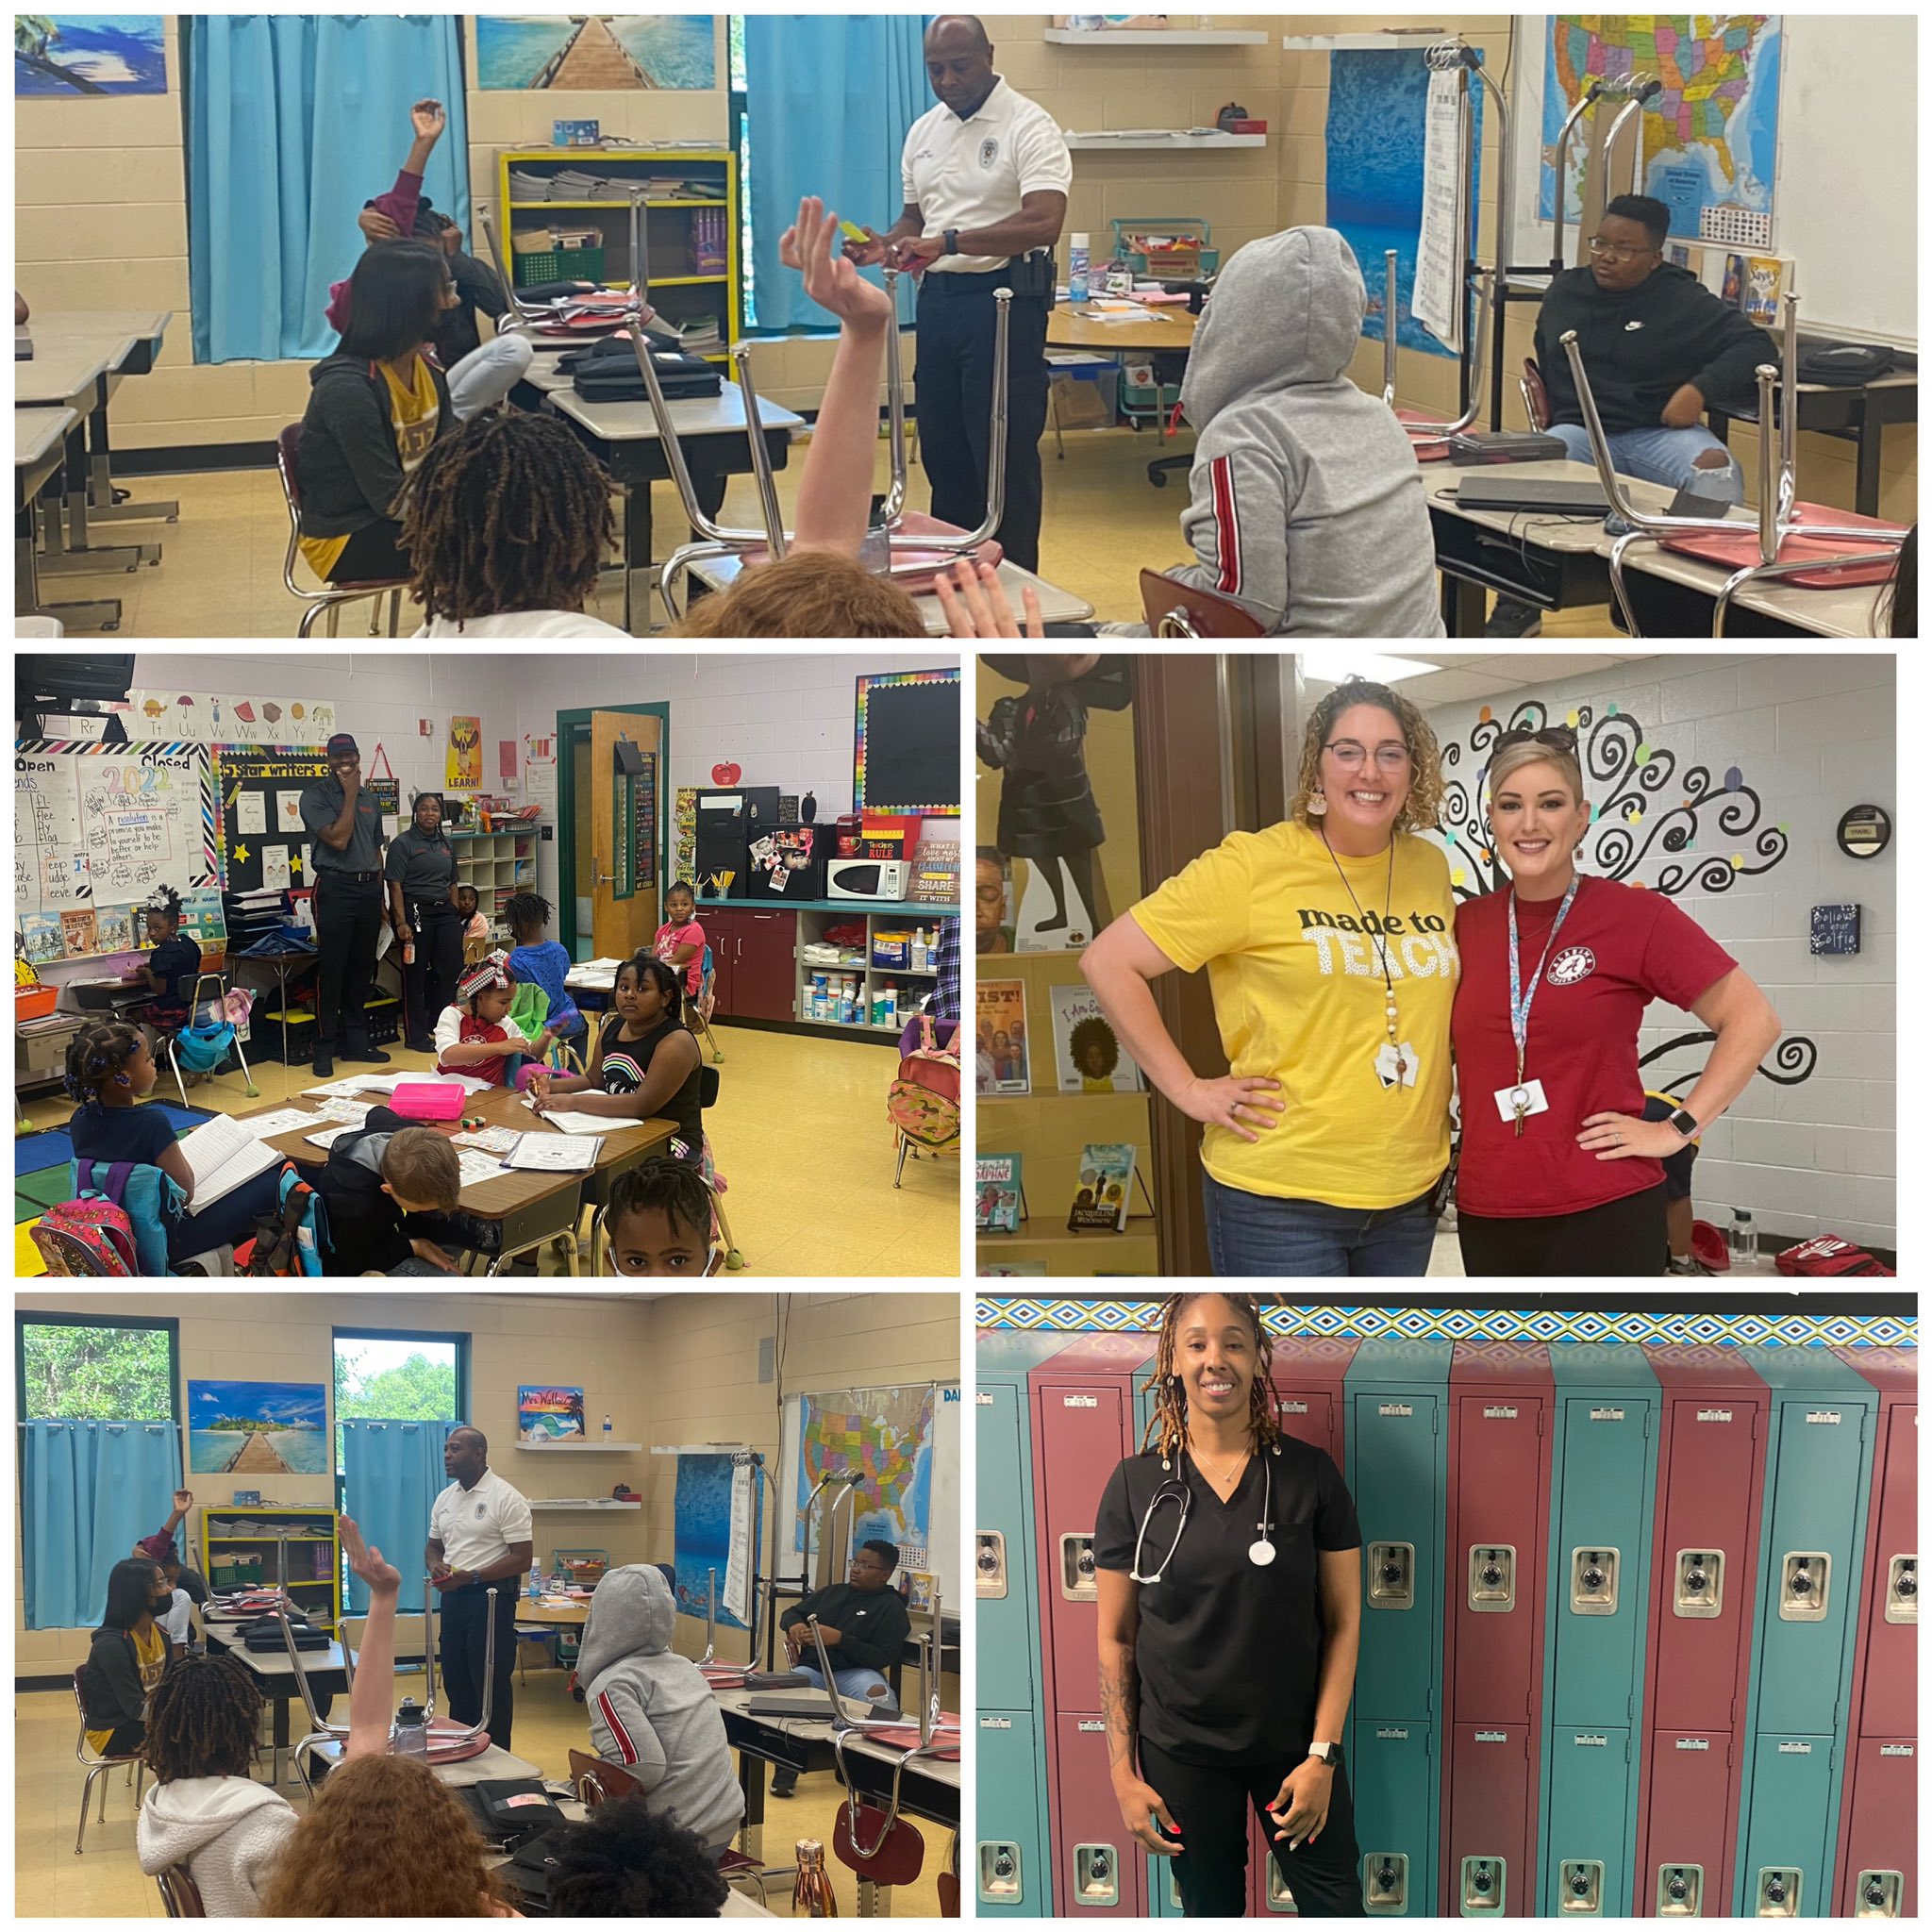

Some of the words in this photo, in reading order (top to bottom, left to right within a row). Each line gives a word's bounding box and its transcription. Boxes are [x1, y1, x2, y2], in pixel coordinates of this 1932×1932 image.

[80, 719, 95, 733] Rr
[149, 721, 162, 735] Tt
[178, 723, 196, 738] Uu
[210, 724, 225, 738] Vv
[236, 724, 257, 740] Ww
[266, 724, 279, 740] Xx
[292, 724, 306, 741] Yy
[318, 727, 330, 741] Zz
[15, 758, 55, 772] Open
[142, 755, 191, 771] Closed
[237, 764, 265, 775] Star
[270, 764, 316, 775] writers
[102, 766, 173, 793] 2022
[448, 777, 479, 788] LEARN!
[108, 816, 113, 824] A
[118, 811, 149, 824] resolution
[38, 821, 51, 835] fly
[108, 825, 132, 839] promise
[134, 824, 144, 836] you
[118, 834, 141, 847] yourself
[111, 846, 130, 855] better
[143, 842, 158, 852] help
[869, 849, 892, 858] RULE
[923, 847, 940, 857] love
[918, 880, 954, 891] SHARE
[1297, 908, 1406, 936] made
[1409, 910, 1446, 934] to
[1830, 923, 1849, 934] your
[1301, 925, 1461, 980] TEACH
[1552, 948, 1593, 968] ALABAMA
[1062, 1009, 1071, 1023] I
[1070, 1003, 1088, 1018] Am
[1074, 1208, 1116, 1219] JACQUELINE
[1076, 1215, 1111, 1224] WOODSON
